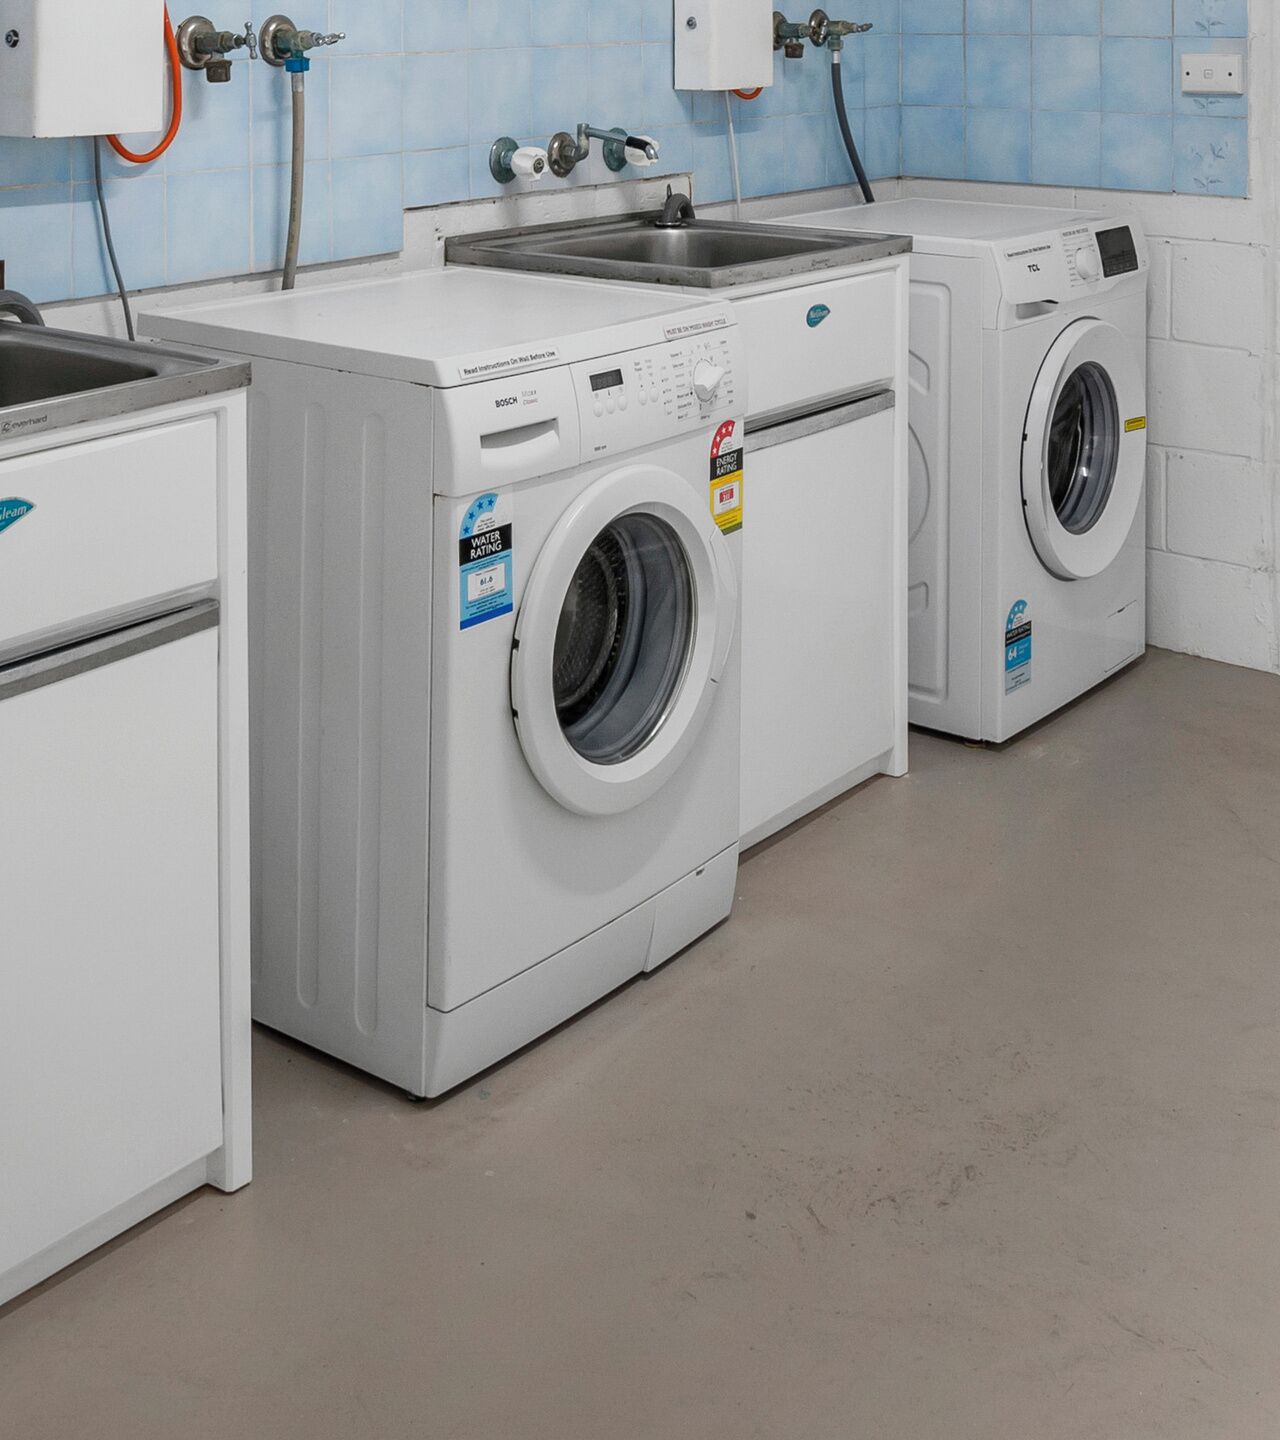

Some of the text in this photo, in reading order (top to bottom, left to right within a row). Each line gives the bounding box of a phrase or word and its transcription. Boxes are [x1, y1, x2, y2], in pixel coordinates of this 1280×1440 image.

[1027, 264, 1041, 273] TCL
[463, 367, 478, 375] Read
[479, 360, 510, 372] Instructions
[519, 355, 529, 363] Wall
[530, 353, 544, 361] Before
[495, 396, 518, 408] BOSCH
[717, 452, 737, 467] ENERGY
[717, 462, 737, 476] RATING
[471, 530, 500, 548] WATER
[470, 541, 502, 560] RATING
